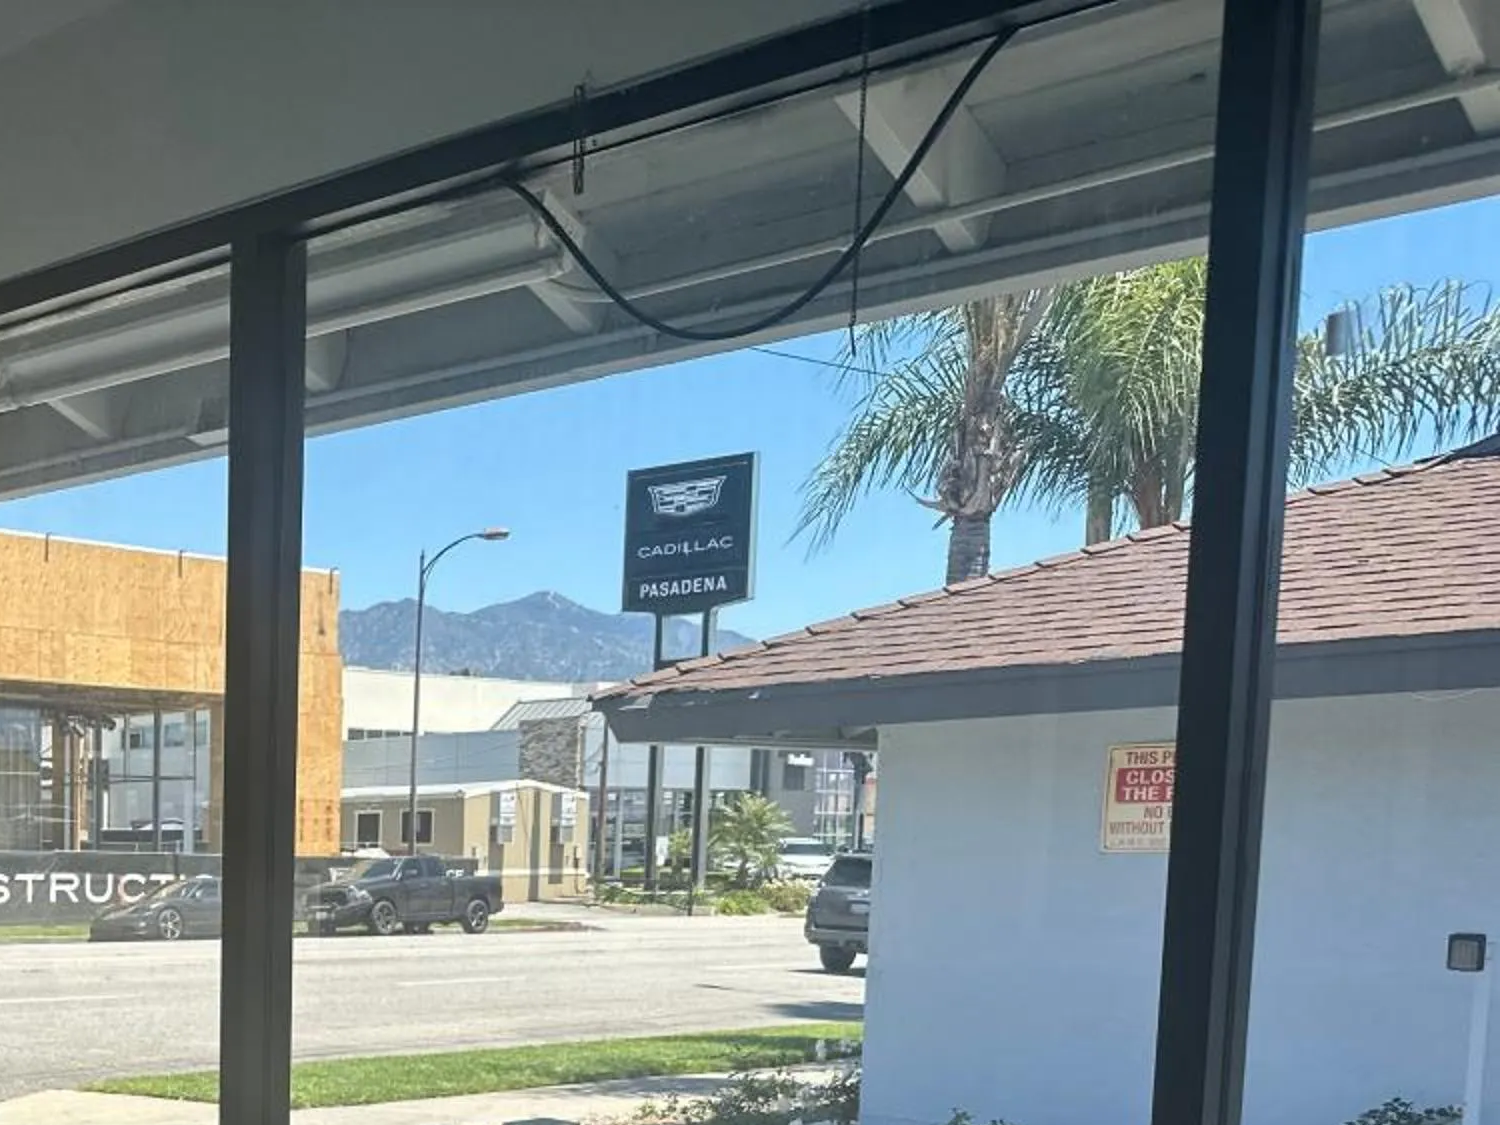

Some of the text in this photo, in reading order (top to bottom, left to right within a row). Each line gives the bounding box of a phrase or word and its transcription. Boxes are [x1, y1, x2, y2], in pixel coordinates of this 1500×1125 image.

[637, 536, 734, 559] CADILLAC
[639, 575, 728, 600] PASADENA
[1125, 751, 1158, 765] THIS
[1123, 786, 1161, 801] THE
[1144, 806, 1163, 818] NO
[1110, 821, 1165, 835] WITHOUT
